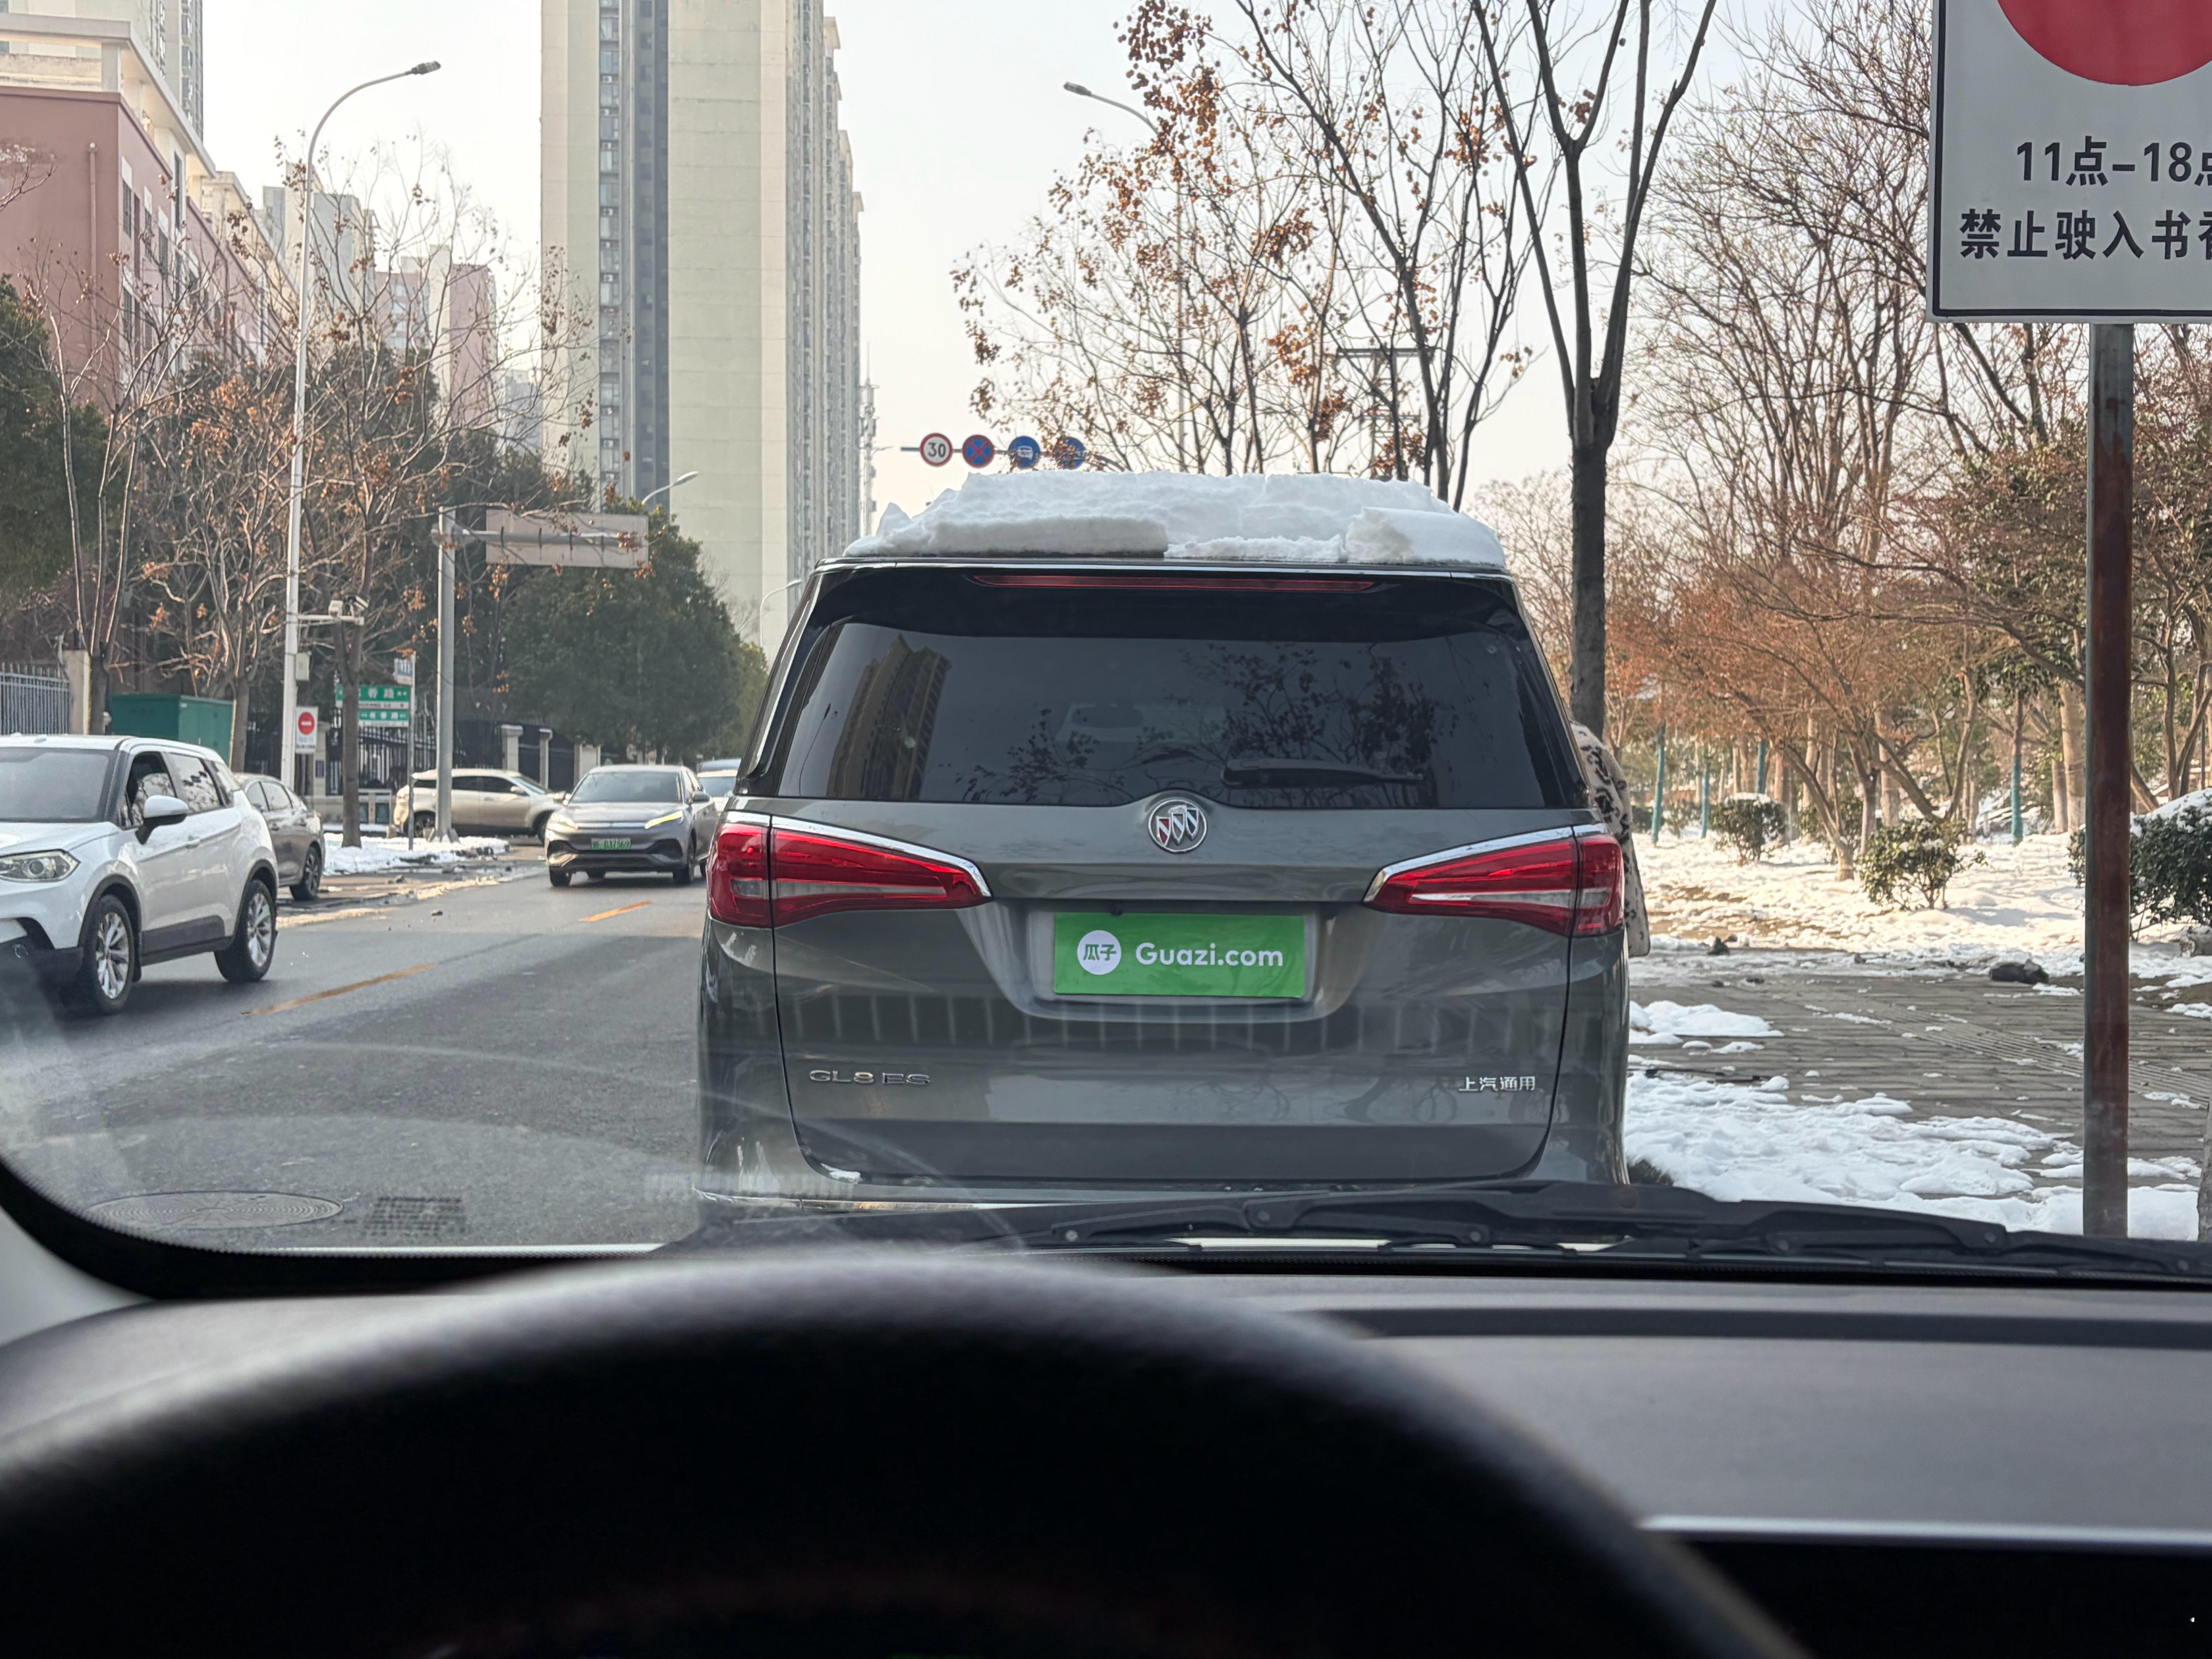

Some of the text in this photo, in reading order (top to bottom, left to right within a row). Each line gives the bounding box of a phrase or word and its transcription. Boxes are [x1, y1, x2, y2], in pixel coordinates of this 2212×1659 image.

[927, 442, 946, 458] 30
[1083, 944, 1117, 962] 瓜子
[1135, 943, 1283, 967] Guazi.com
[809, 1070, 930, 1084] GL8 ES
[1458, 1076, 1535, 1092] 上汽通用
